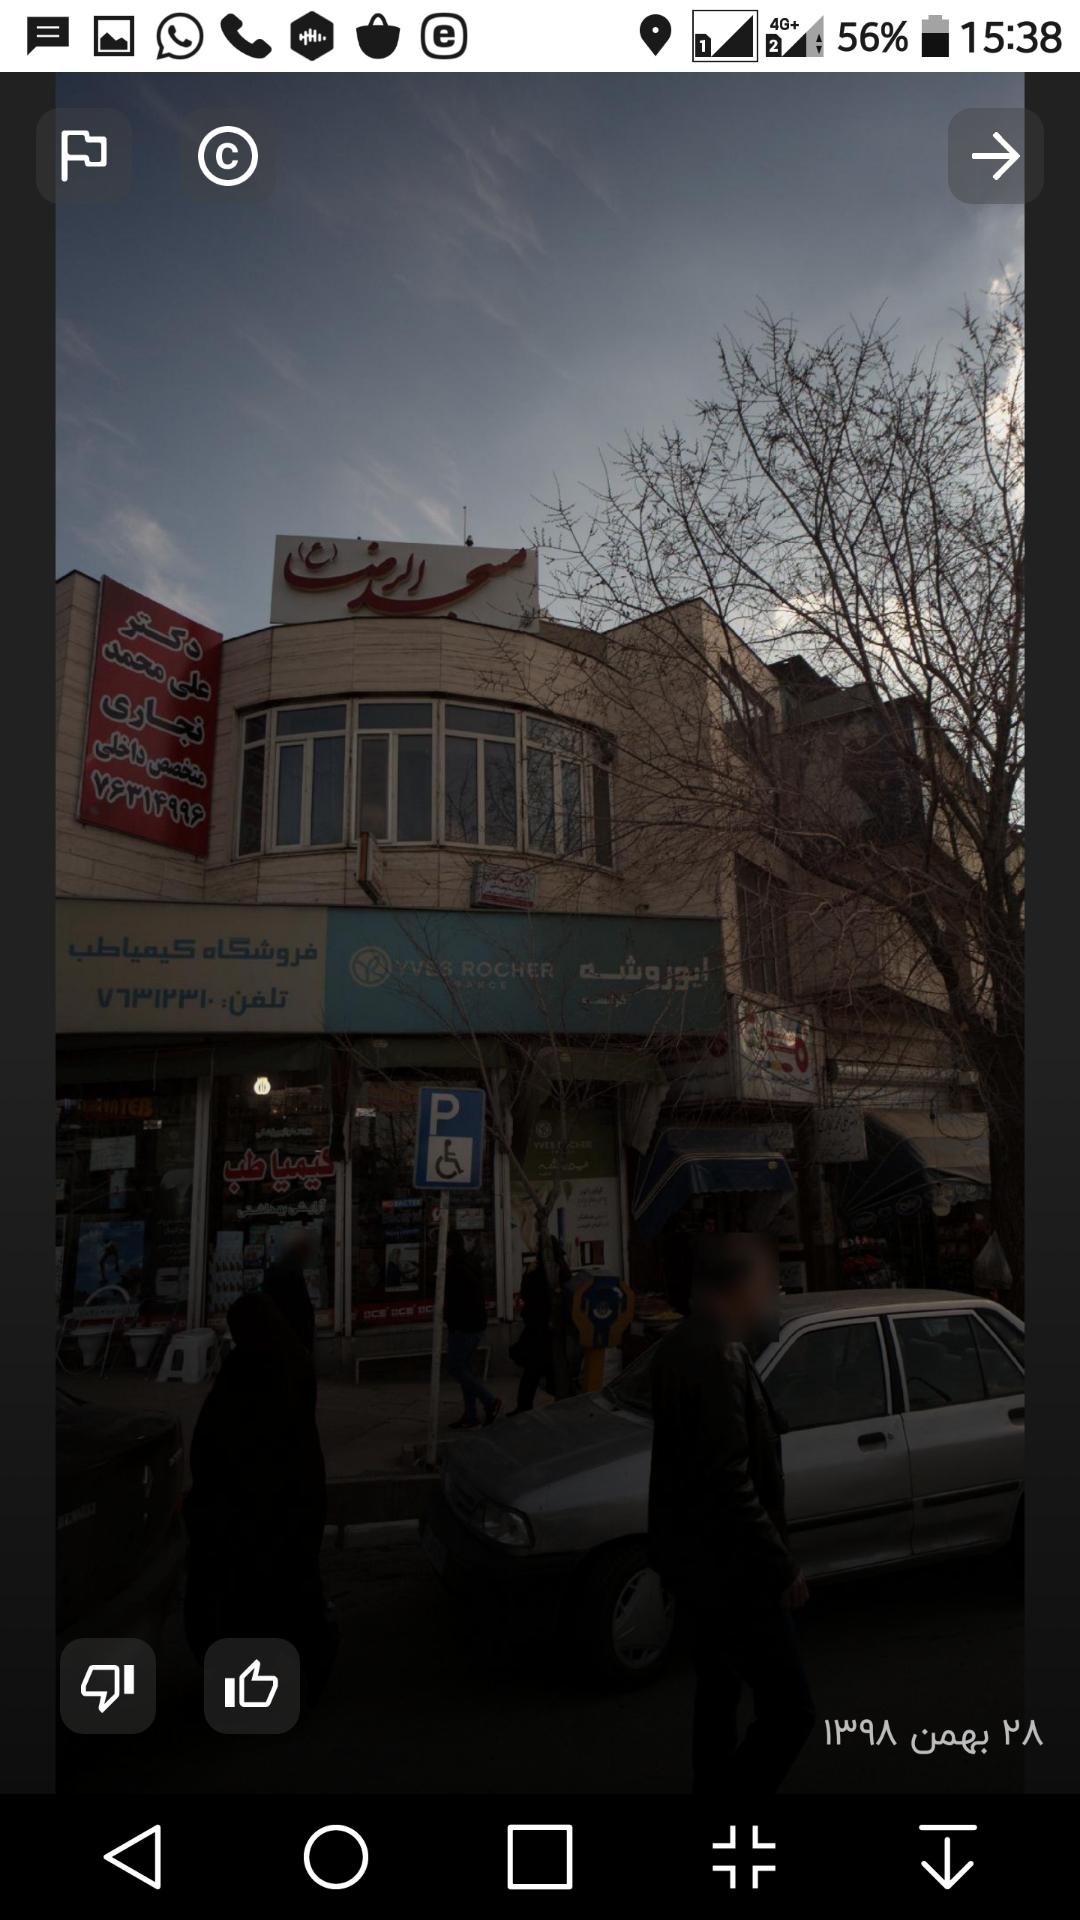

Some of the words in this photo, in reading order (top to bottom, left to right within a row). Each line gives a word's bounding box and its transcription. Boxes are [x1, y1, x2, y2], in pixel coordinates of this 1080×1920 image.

[118, 611, 203, 661] دکتر
[102, 639, 165, 684] محمد
[167, 670, 211, 702] علی
[100, 693, 206, 748] نجاری
[93, 731, 148, 768] داخلی
[147, 757, 208, 790] متخصص
[202, 938, 318, 967] فروشگاه
[460, 960, 555, 979] ROCHER
[429, 1092, 461, 1137] P
[223, 1147, 268, 1195] طب
[270, 1146, 337, 1193] کیمیا
